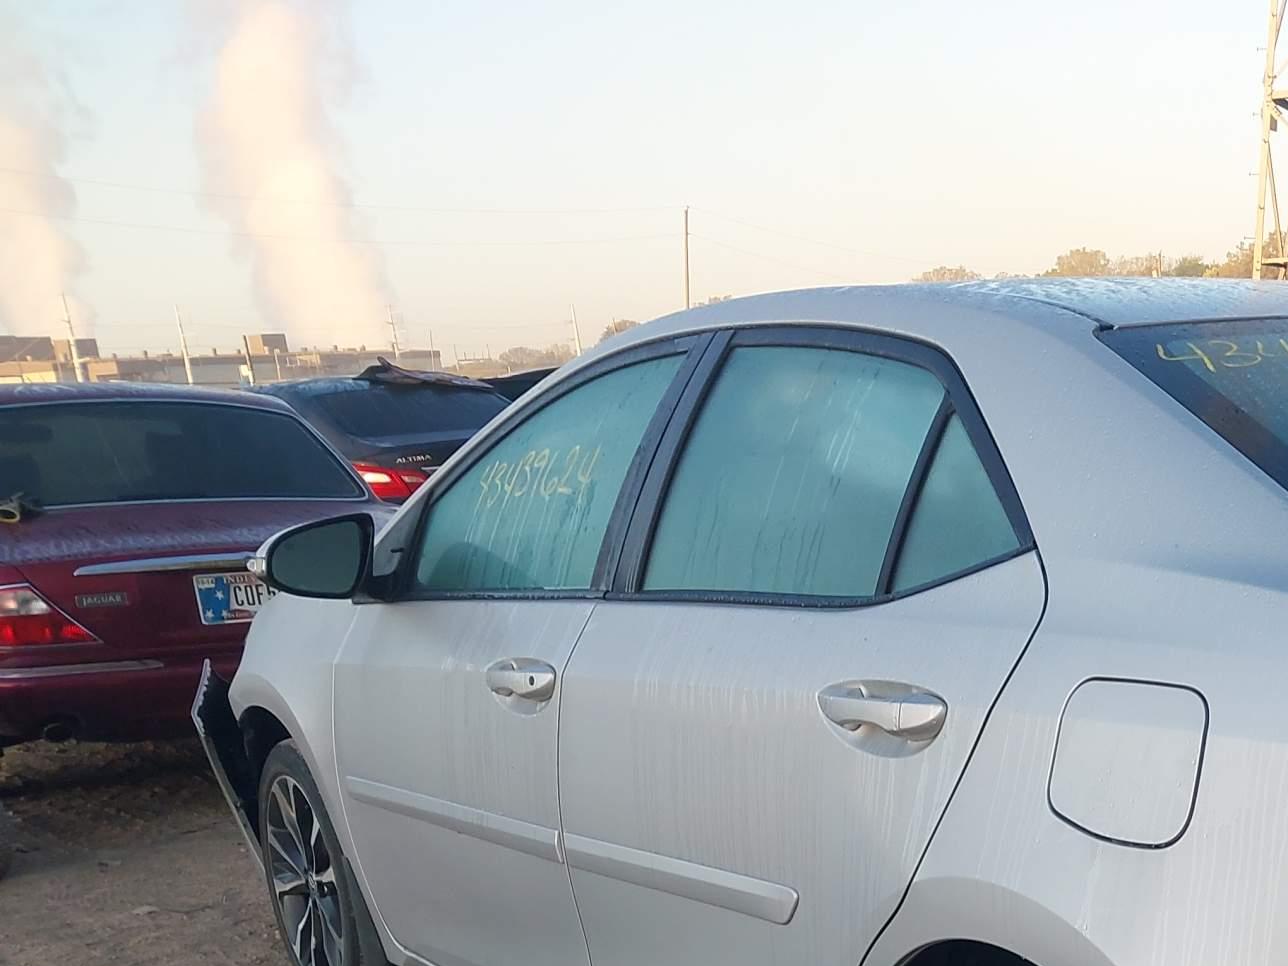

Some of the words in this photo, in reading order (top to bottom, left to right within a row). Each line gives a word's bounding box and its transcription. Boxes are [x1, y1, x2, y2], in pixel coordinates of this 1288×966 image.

[396, 454, 432, 464] ALTIMA
[480, 445, 600, 509] 43439624
[82, 594, 122, 607] JAGUAR
